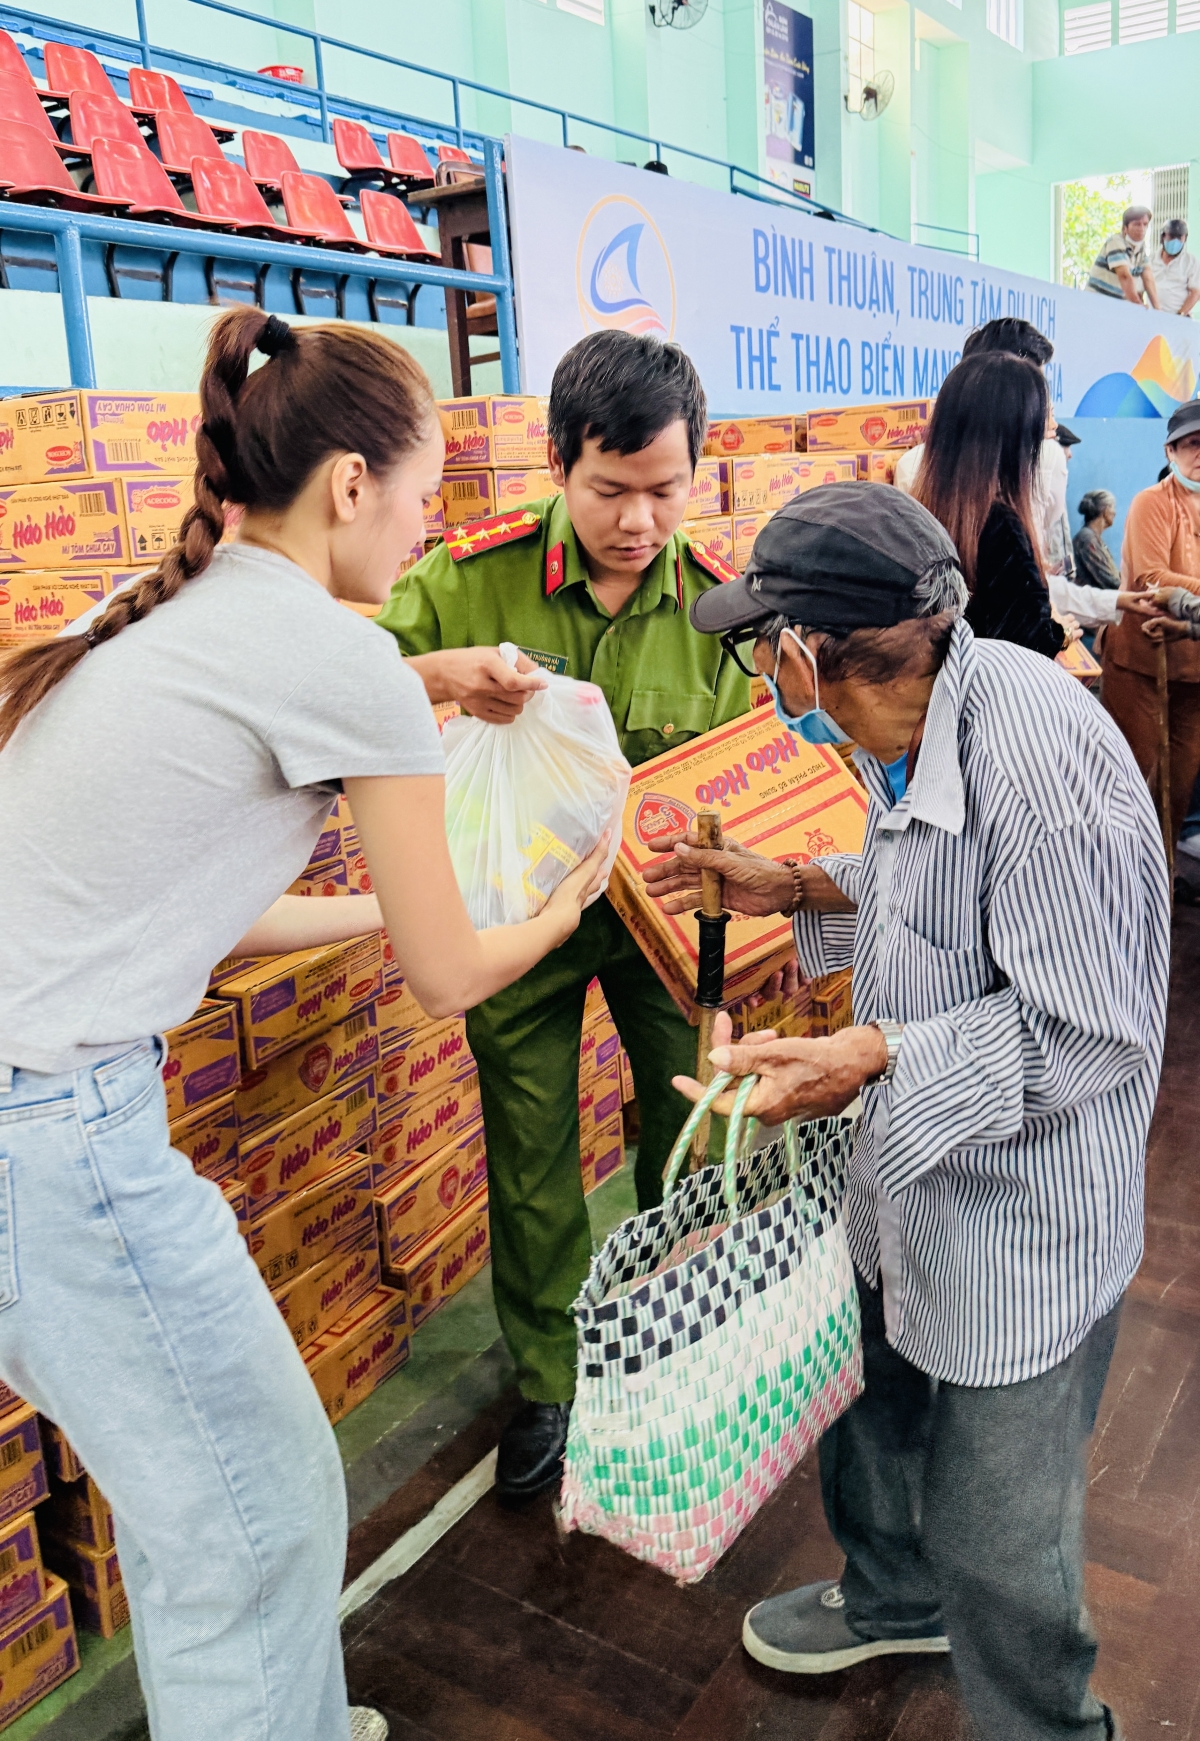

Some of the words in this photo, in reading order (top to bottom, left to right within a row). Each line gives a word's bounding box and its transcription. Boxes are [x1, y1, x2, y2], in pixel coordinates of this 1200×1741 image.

[753, 225, 815, 301] BÌNH
[824, 246, 900, 327] THUẬN,
[908, 265, 964, 325] TRUNG
[970, 278, 1001, 326] TÂM
[730, 315, 782, 391] THỂ
[791, 332, 851, 395] THAO
[861, 331, 904, 397] BIỂN
[146, 418, 188, 452] Hảo
[12, 514, 43, 549] Hảo
[44, 505, 76, 540] Hảo
[14, 597, 38, 624] Hảo
[39, 591, 64, 619] Hảo
[746, 731, 800, 775] Hảo
[695, 763, 750, 807] Hảo
[408, 1052, 436, 1086] Hảo
[437, 1031, 464, 1065] Hảo
[279, 1144, 310, 1185] Hảo
[312, 1116, 342, 1156] Hảo
[406, 1119, 433, 1154] Hảo
[434, 1096, 459, 1130] Hảo
[302, 1215, 329, 1246] Hảo
[331, 1194, 357, 1226] Hảo
[441, 1253, 464, 1290] Hảo
[465, 1226, 486, 1261] Hảo
[347, 1357, 371, 1388] Hảo
[371, 1332, 394, 1362] Hảo
